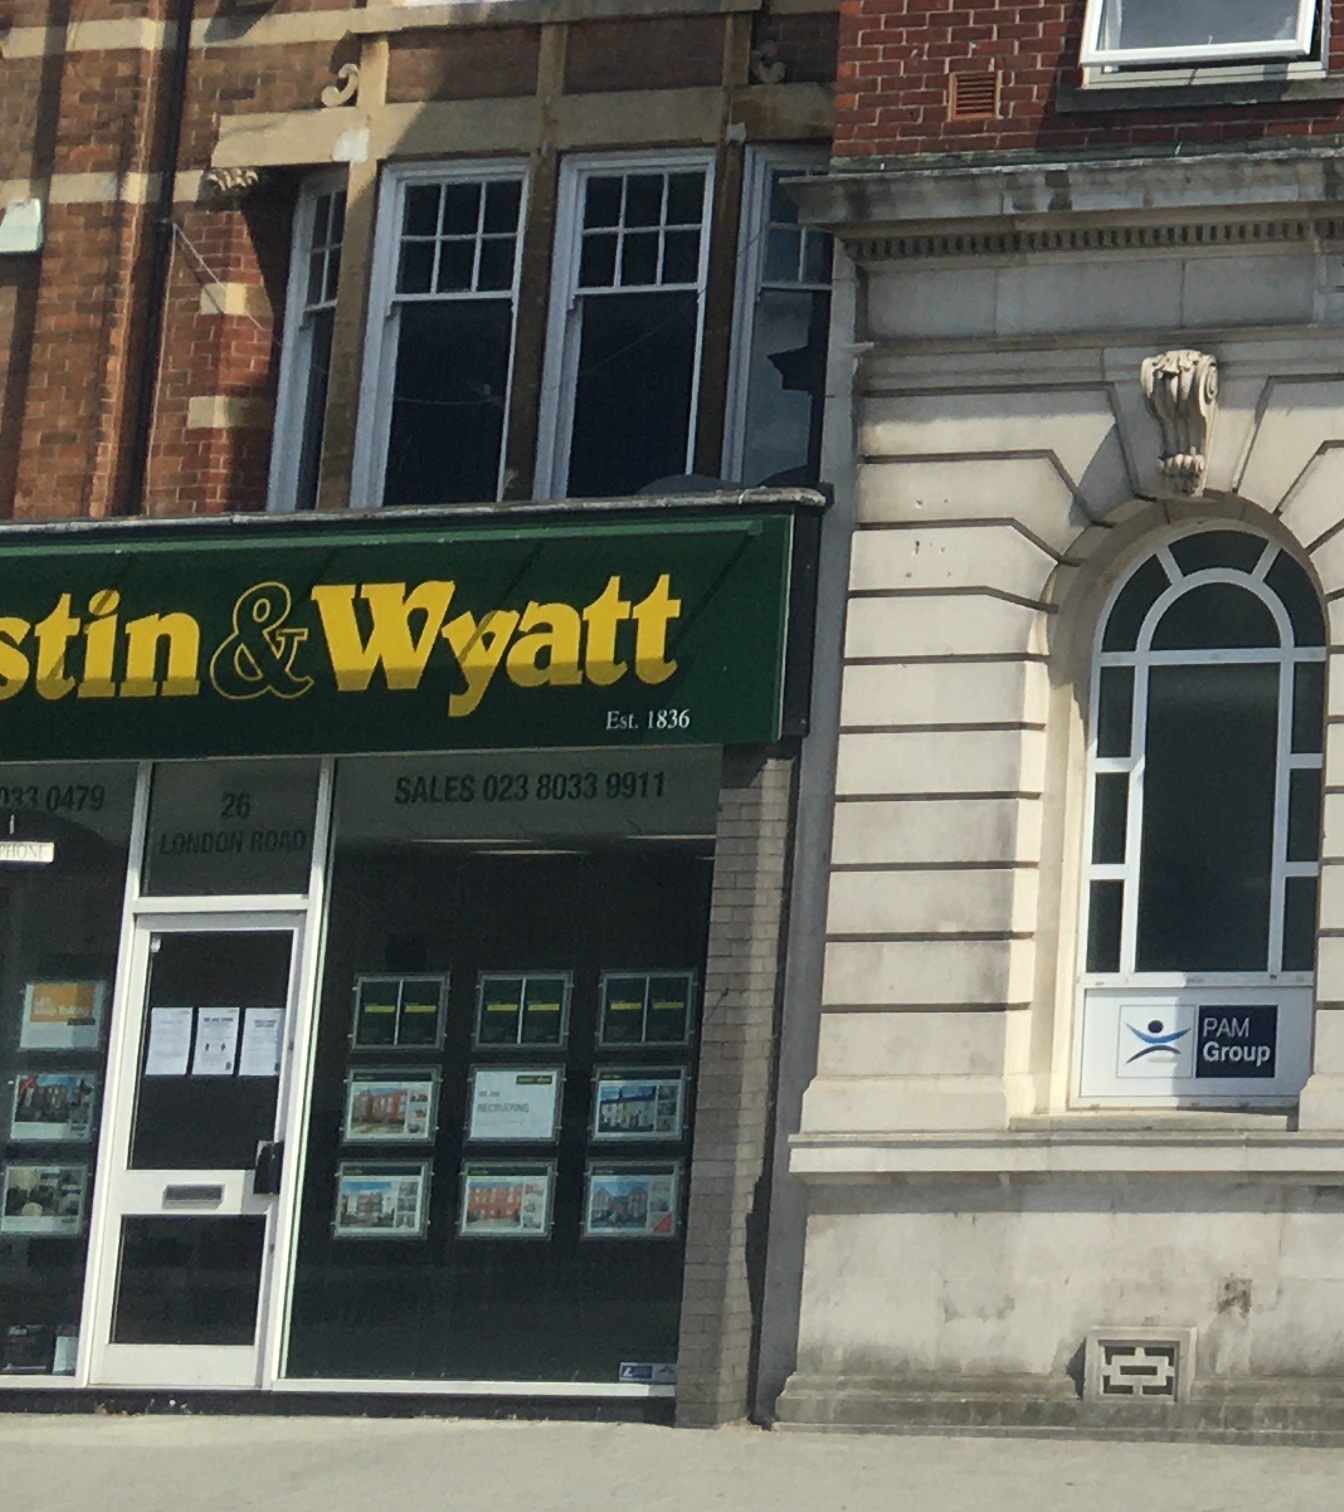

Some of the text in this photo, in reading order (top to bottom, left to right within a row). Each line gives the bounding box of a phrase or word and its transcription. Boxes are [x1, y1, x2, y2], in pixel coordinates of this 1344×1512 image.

[209, 581, 314, 700] &
[311, 573, 682, 717] Wyatt
[606, 708, 690, 730] Est. 1836
[45, 784, 106, 812] 0479
[394, 770, 666, 805] SALES 023 8033 9911
[220, 791, 252, 819] 26
[159, 828, 308, 856] LONDON ROAD
[1202, 1017, 1250, 1038] PAM
[1202, 1040, 1271, 1067] Group
